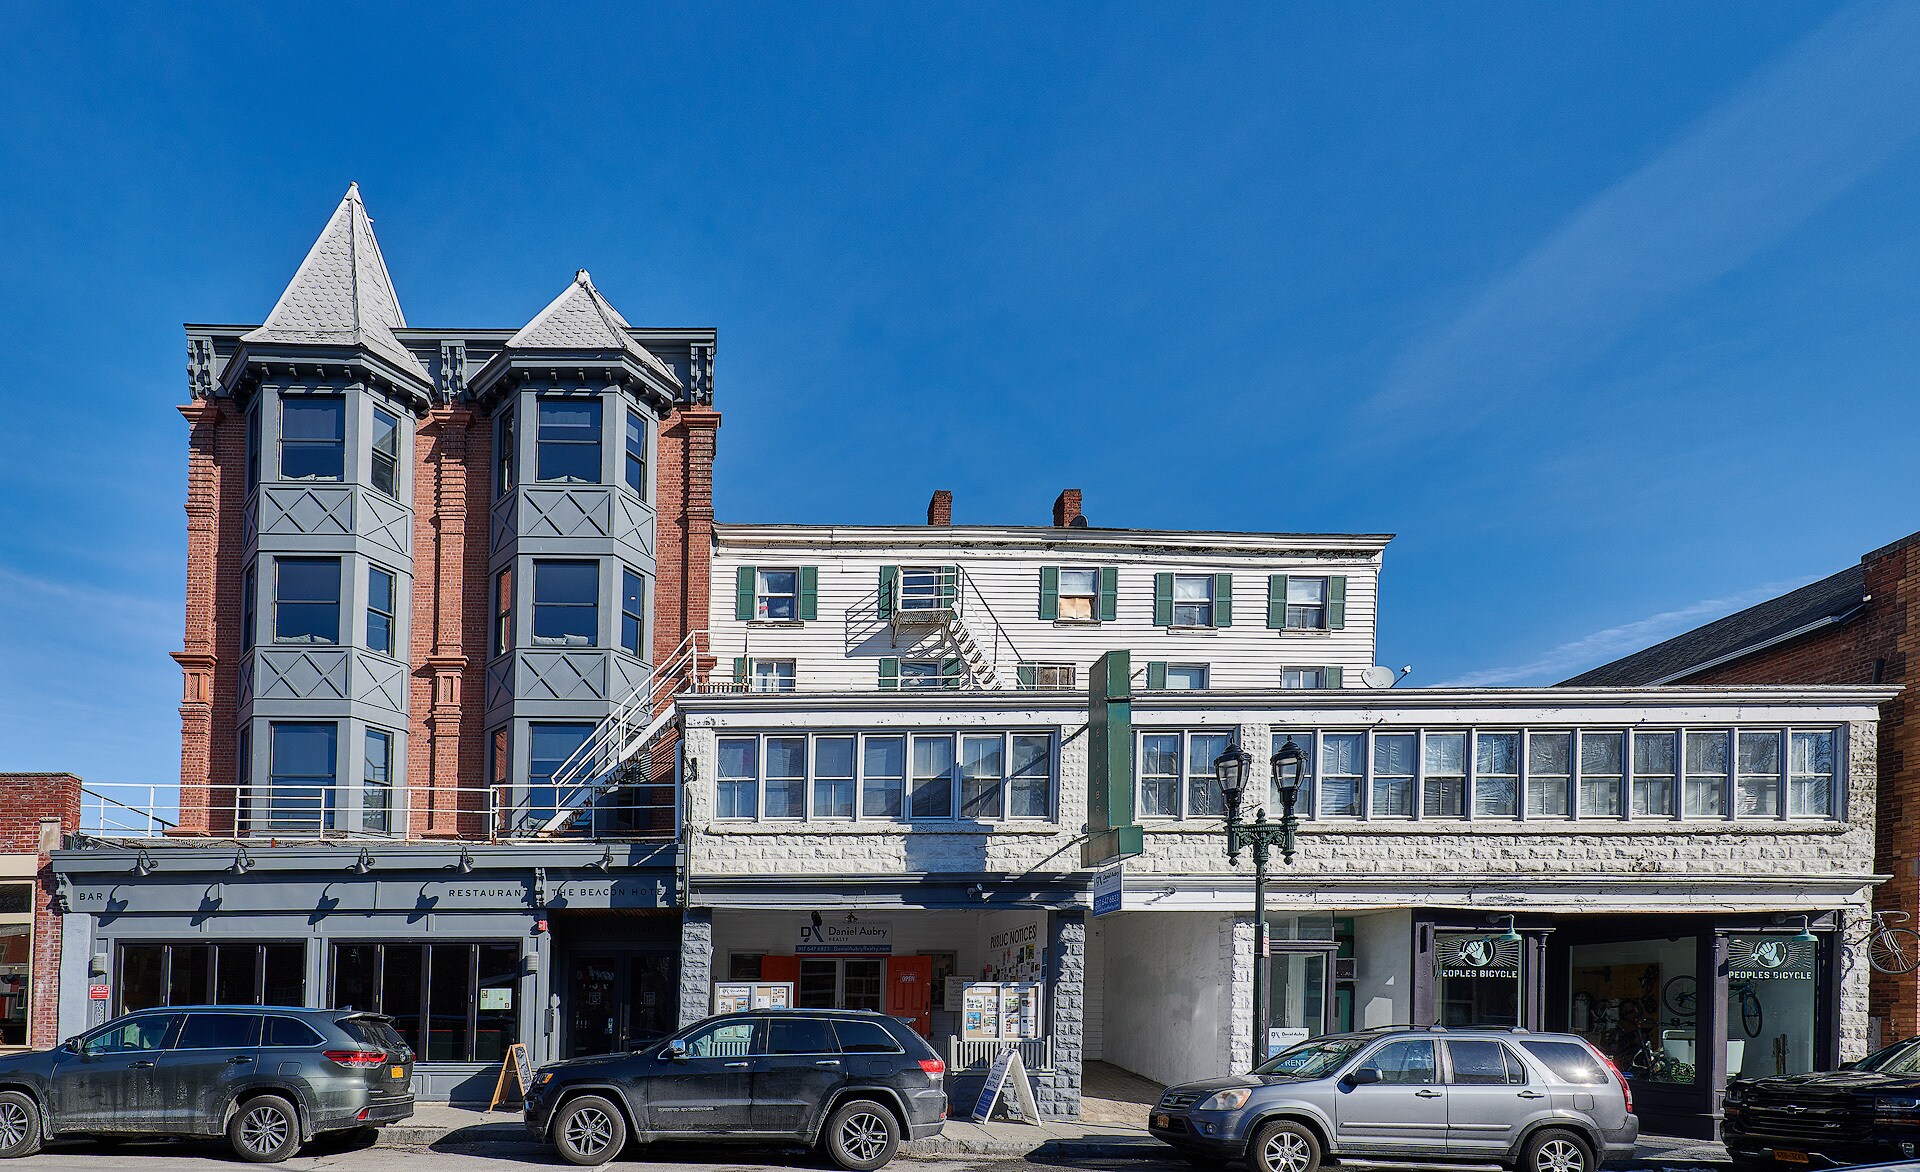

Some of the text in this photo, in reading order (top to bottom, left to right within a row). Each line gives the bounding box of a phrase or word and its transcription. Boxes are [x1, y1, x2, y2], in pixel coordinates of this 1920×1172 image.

[552, 888, 669, 896] THE BEACON HOTEL
[828, 926, 857, 936] Daniel
[859, 926, 887, 938] Aubry
[990, 924, 1037, 949] PUBLIC NOTICES
[1480, 969, 1518, 978] BICYCLE
[1728, 970, 1812, 979] PEOPLES BICYCLE
[1285, 1059, 1307, 1067] RENT
